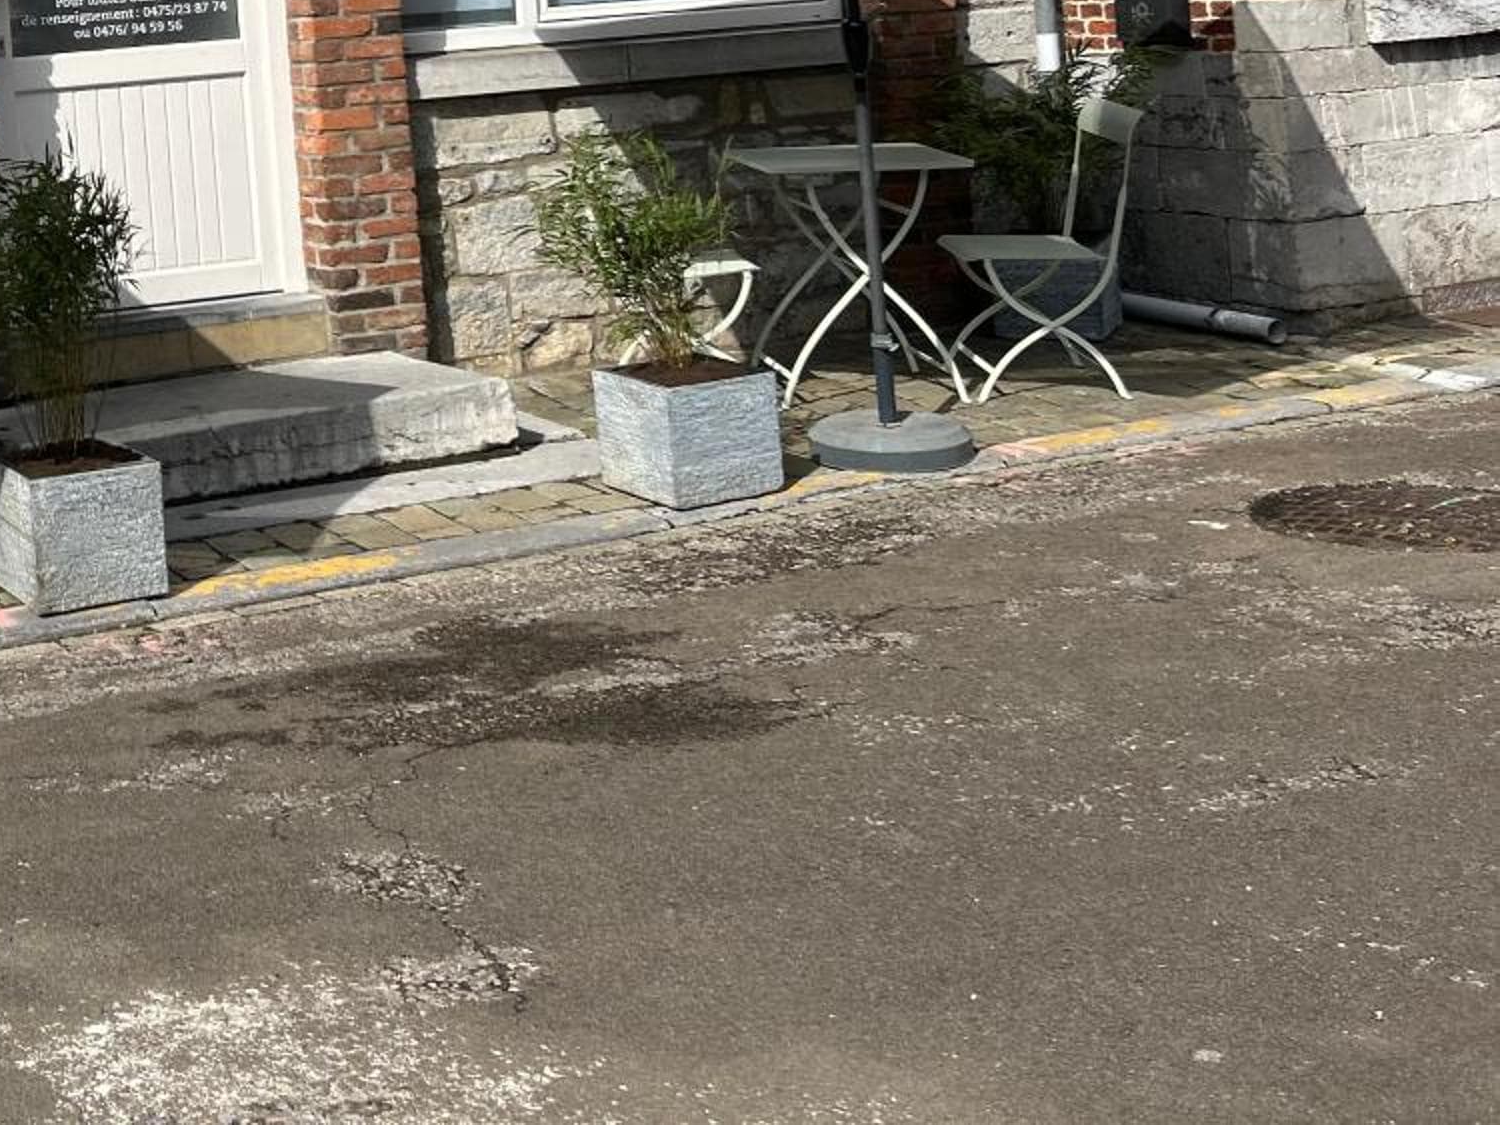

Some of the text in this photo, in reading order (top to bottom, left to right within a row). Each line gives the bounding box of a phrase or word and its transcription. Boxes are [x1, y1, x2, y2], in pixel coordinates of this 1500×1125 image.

[21, 13, 37, 27] de
[195, 1, 209, 14] 87
[73, 28, 91, 40] ou
